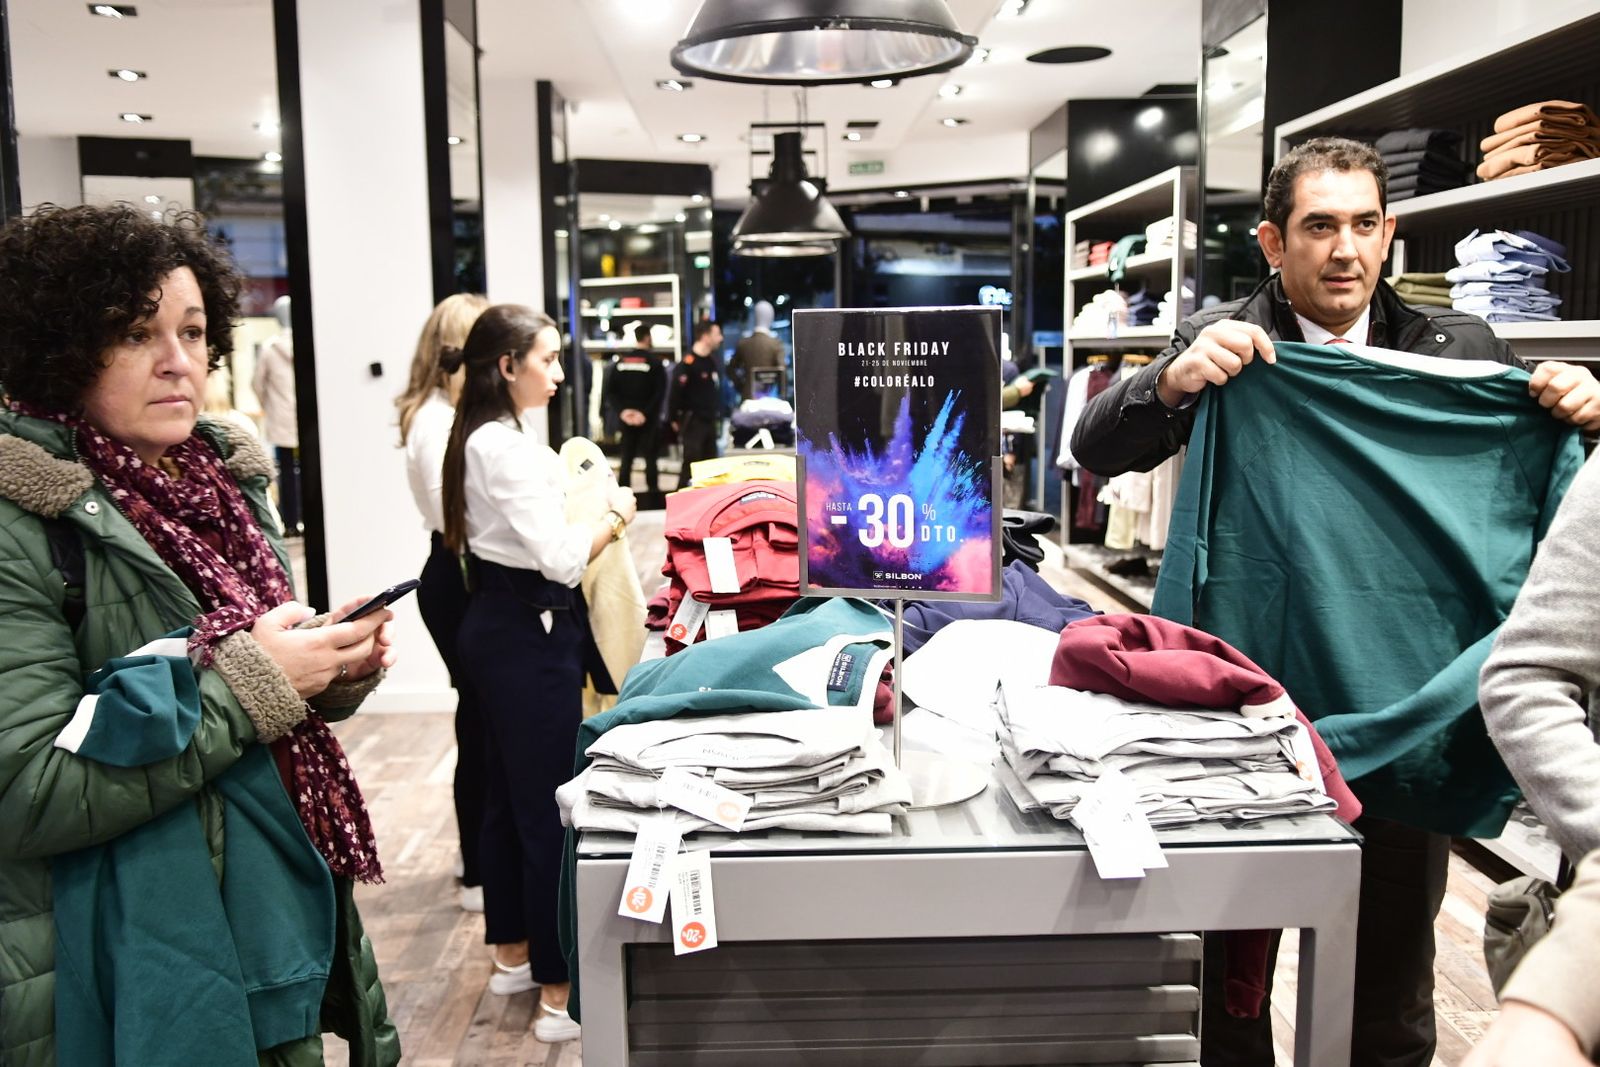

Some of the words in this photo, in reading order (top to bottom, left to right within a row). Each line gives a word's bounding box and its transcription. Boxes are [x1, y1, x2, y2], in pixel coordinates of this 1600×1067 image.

[838, 342, 886, 356] BLACK
[894, 342, 949, 356] FRIDAY
[854, 374, 935, 388] #COLORÉALO
[826, 502, 852, 512] HASTA
[921, 525, 964, 543] DTO.
[885, 572, 922, 580] SILBON
[835, 661, 848, 686] SILBON
